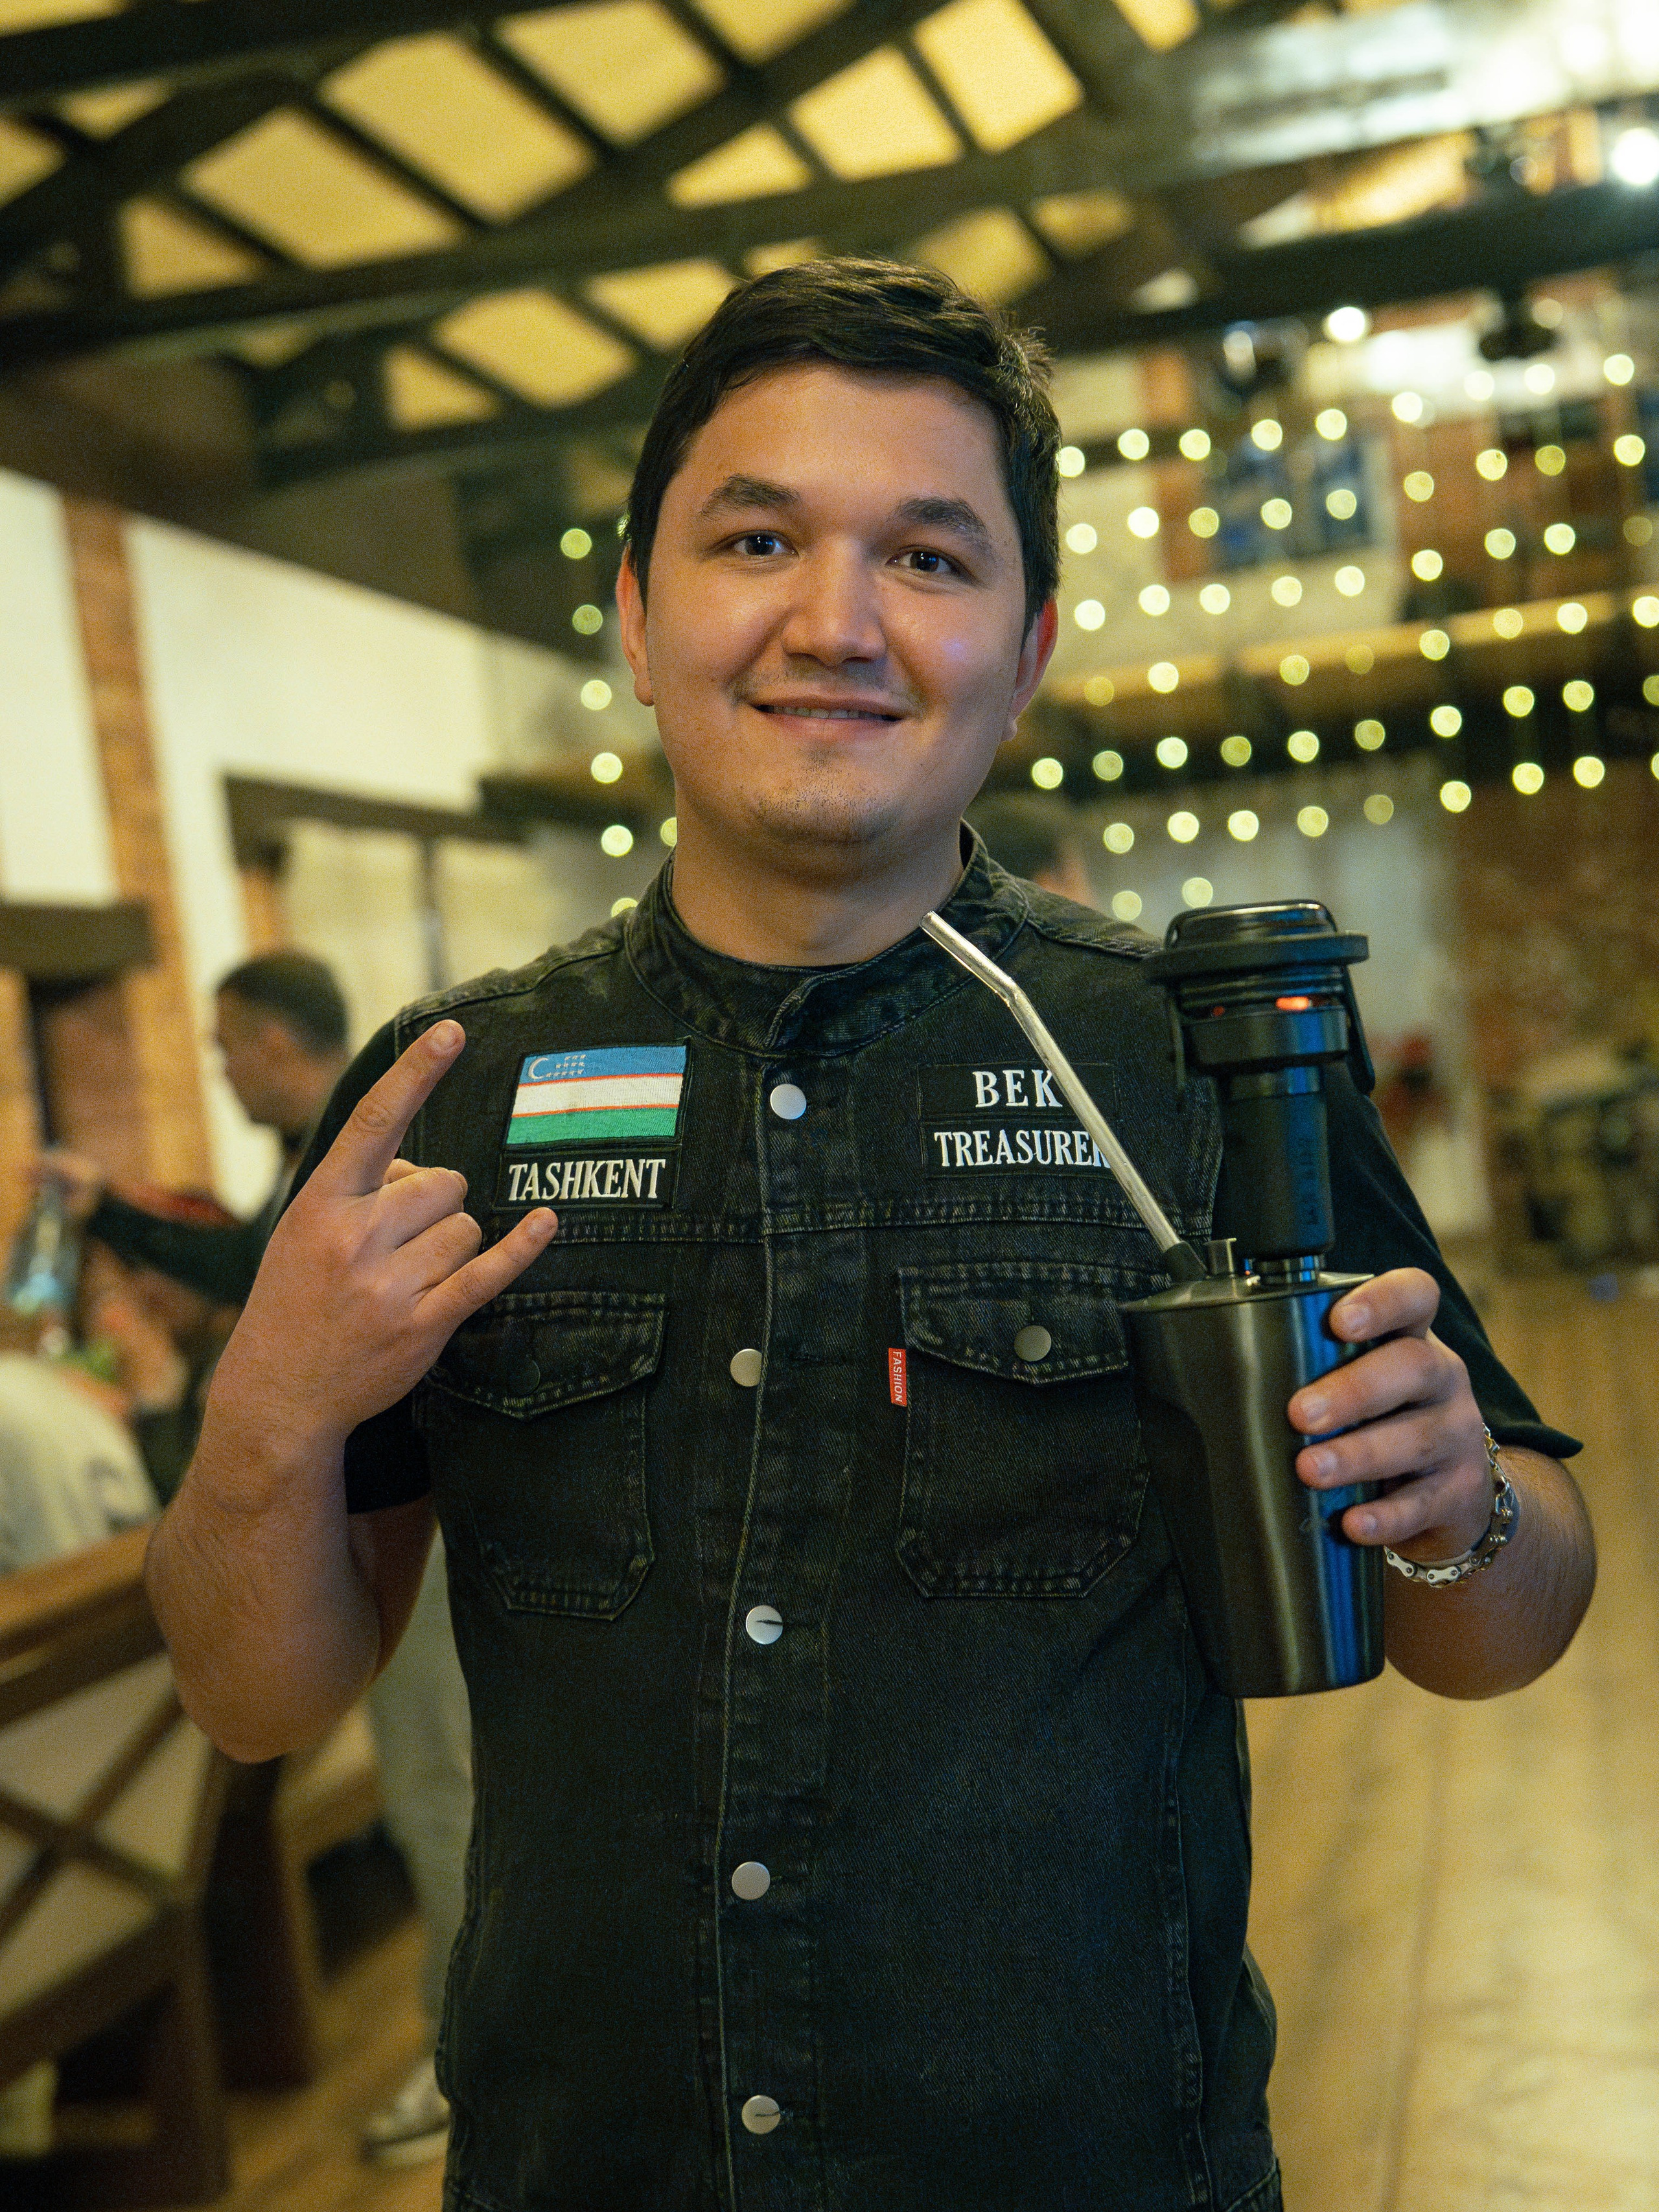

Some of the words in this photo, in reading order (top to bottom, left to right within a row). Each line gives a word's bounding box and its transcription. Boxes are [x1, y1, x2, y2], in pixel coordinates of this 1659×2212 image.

[972, 1069, 1063, 1107] BEK
[509, 1159, 666, 1200] TASHKENT
[892, 1351, 903, 1403] FASHION
